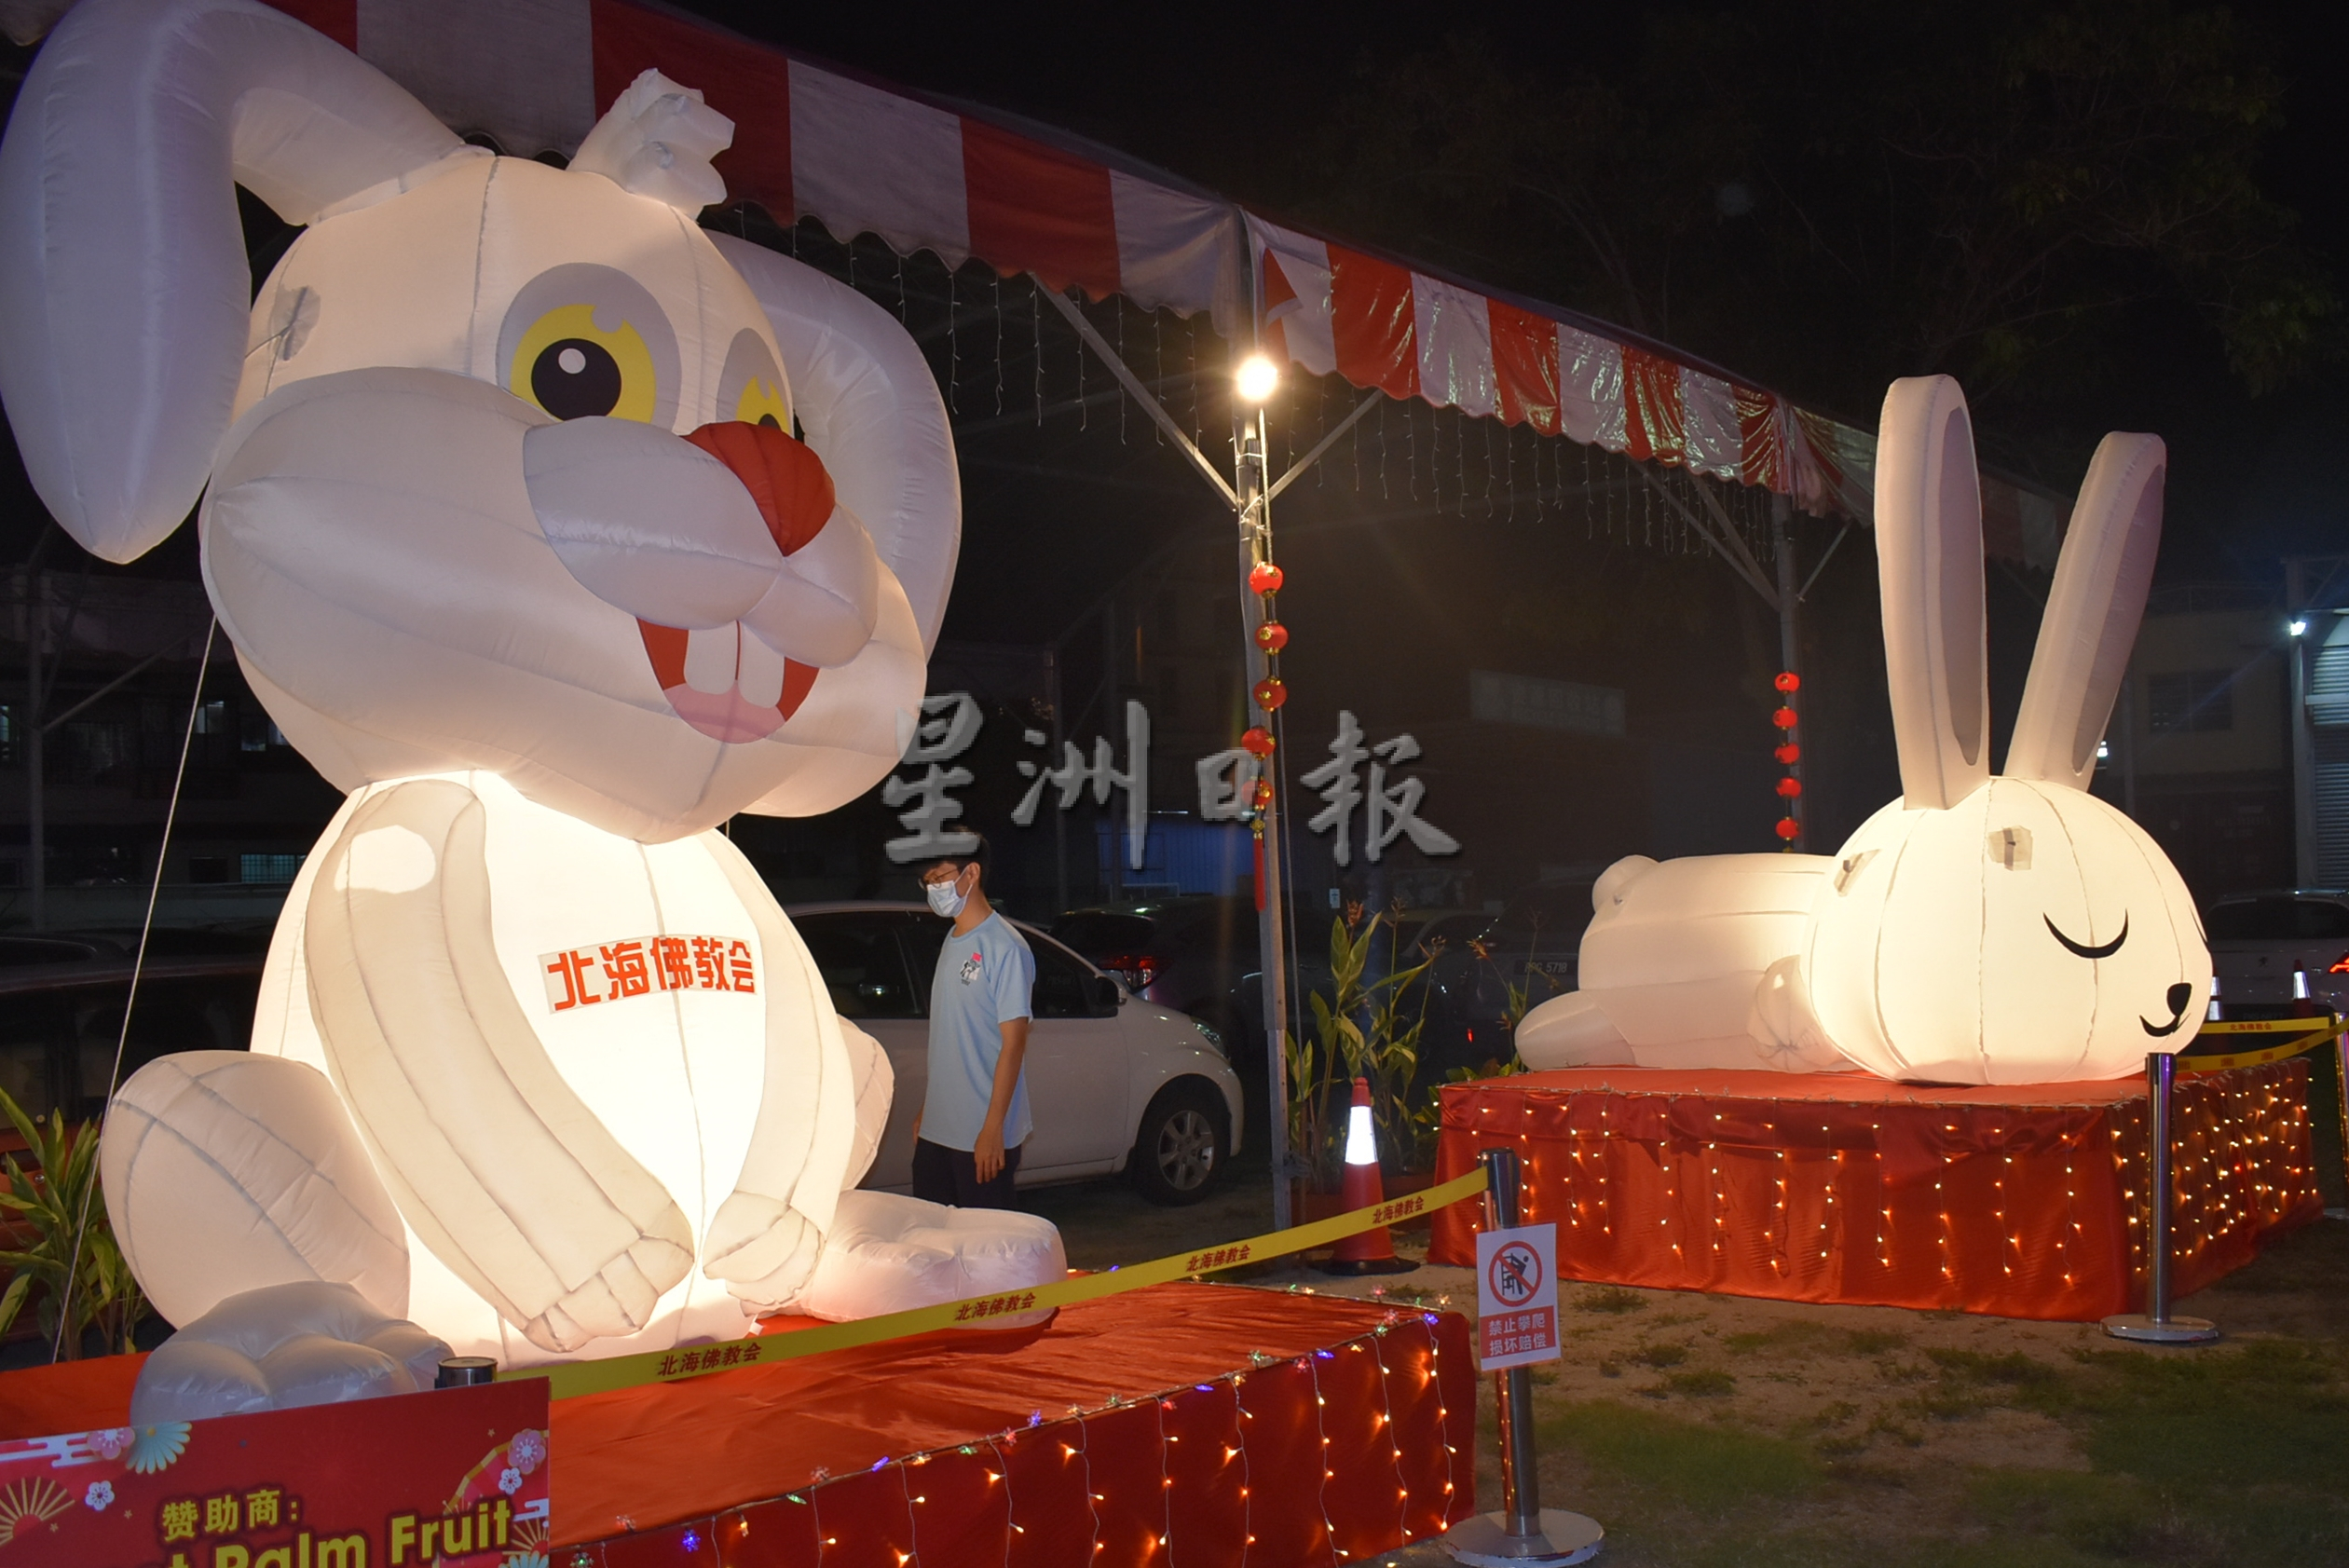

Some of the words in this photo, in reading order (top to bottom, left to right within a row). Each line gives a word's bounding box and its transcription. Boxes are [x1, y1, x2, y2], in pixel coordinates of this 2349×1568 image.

[547, 935, 756, 1011] 北海佛教会
[1372, 1196, 1425, 1224] 北海佛教会
[1186, 1244, 1251, 1272] 北海佛教会
[955, 1292, 1036, 1321] 北海佛教会
[1489, 1313, 1546, 1336] 禁止攀爬
[1489, 1333, 1547, 1356] 损坏赔偿
[658, 1343, 762, 1376] 北海佛教会
[391, 1499, 511, 1563] Fruit
